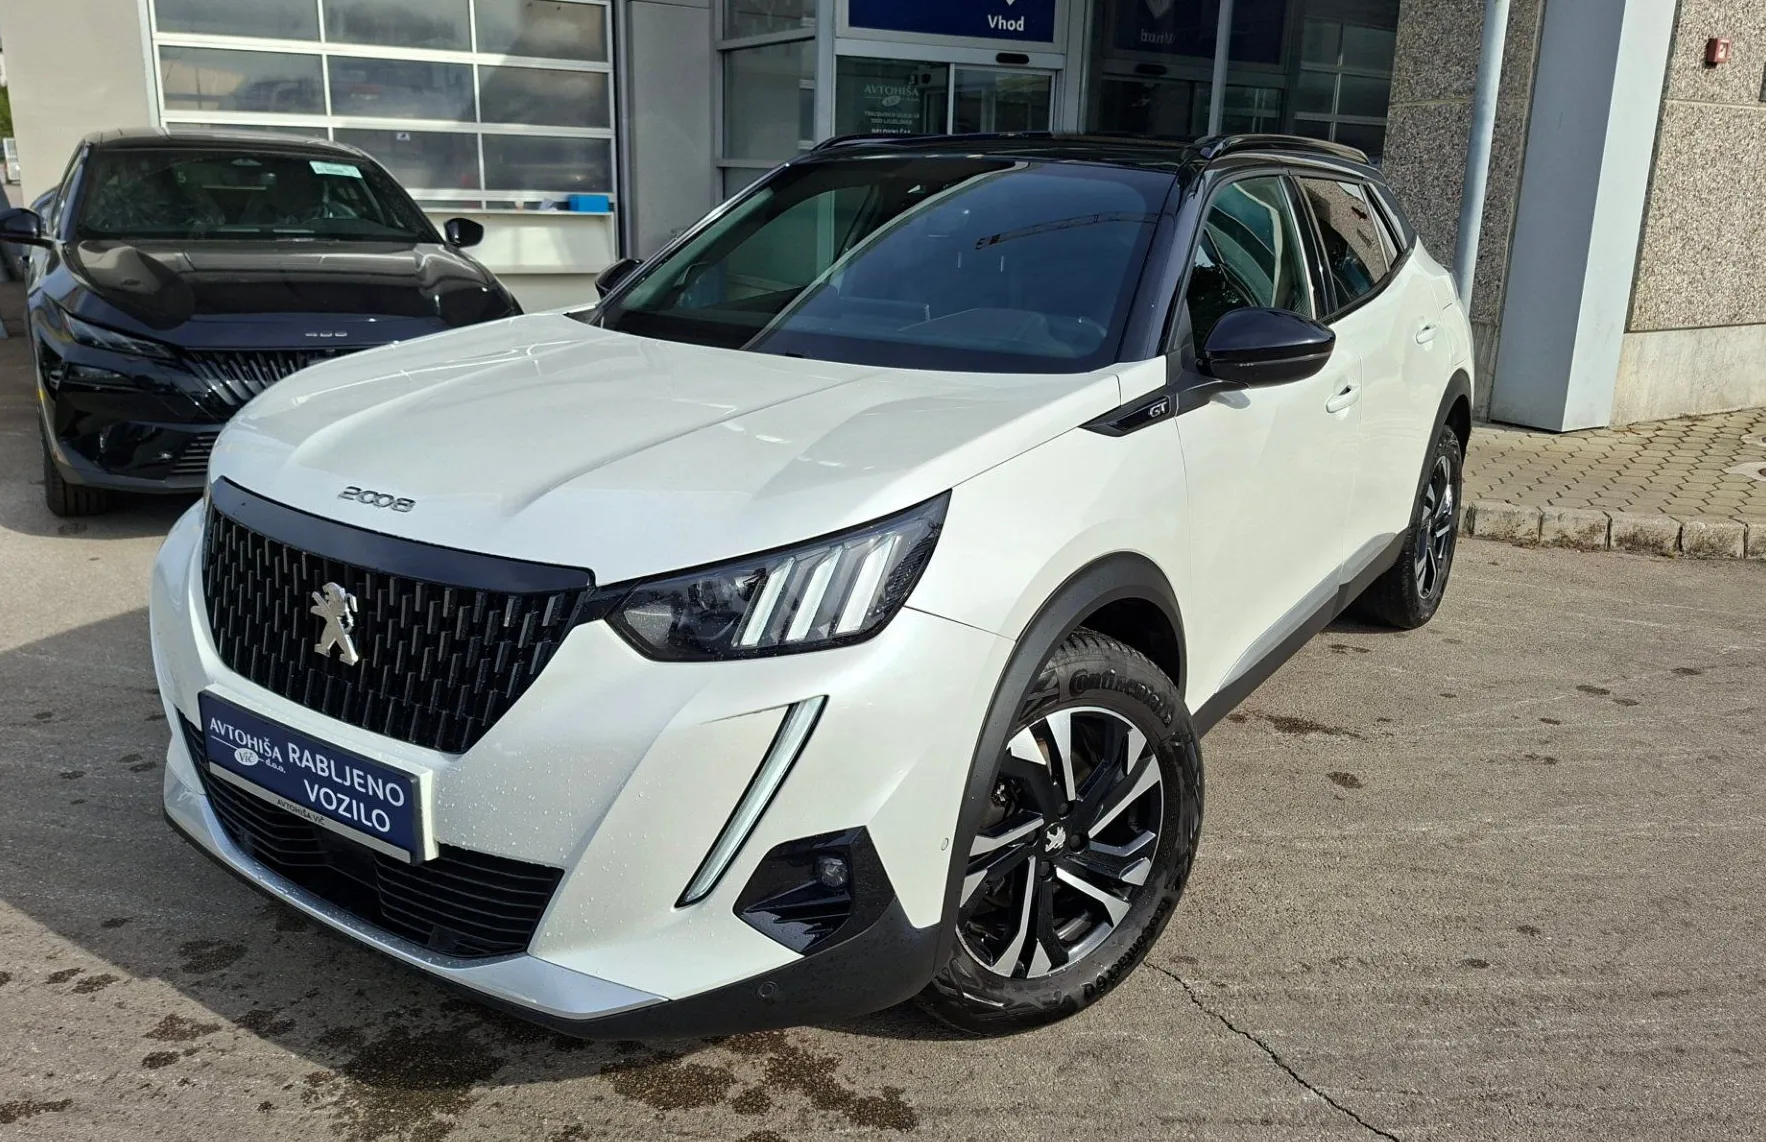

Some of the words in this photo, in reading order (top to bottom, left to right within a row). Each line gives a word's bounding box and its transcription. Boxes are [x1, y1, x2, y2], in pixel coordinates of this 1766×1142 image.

[987, 14, 1024, 31] Vhod
[1149, 401, 1168, 418] GT
[337, 486, 416, 513] 2008
[209, 717, 283, 763] AVTOHIŠA
[238, 750, 256, 764] Vič
[265, 758, 287, 774] d.o.o.
[287, 742, 405, 807] RABLJENO
[276, 798, 312, 820] AVTOHIŠA
[303, 779, 391, 833] VOZILO
